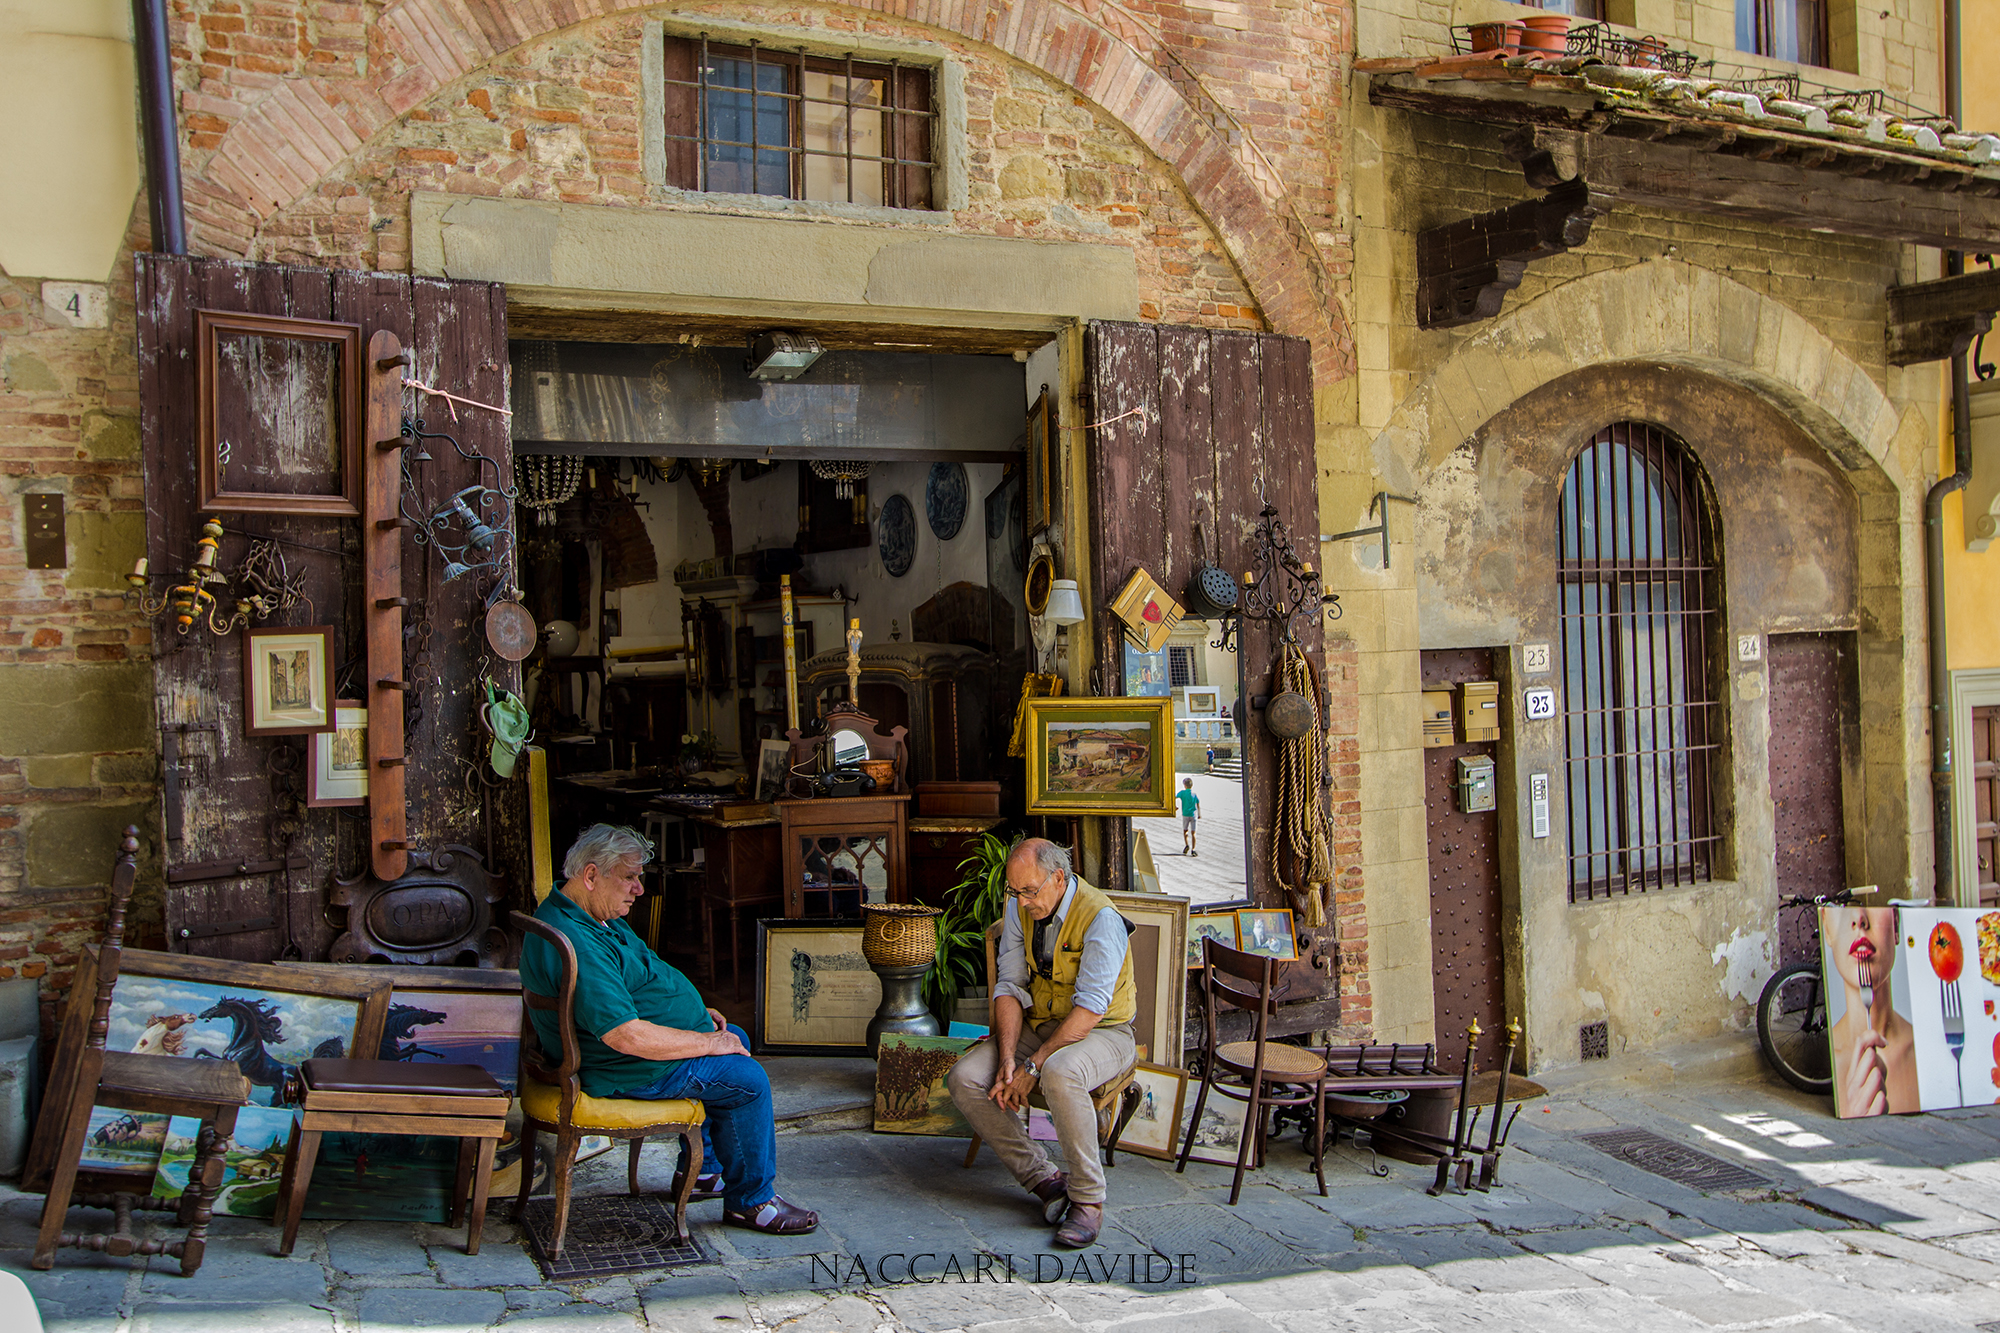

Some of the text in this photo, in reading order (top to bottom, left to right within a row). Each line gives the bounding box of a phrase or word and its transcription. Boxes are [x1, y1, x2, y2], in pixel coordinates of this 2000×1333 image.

[65, 292, 81, 318] 4
[1743, 640, 1757, 656] 24
[1528, 649, 1546, 667] 23
[1532, 695, 1550, 714] 23
